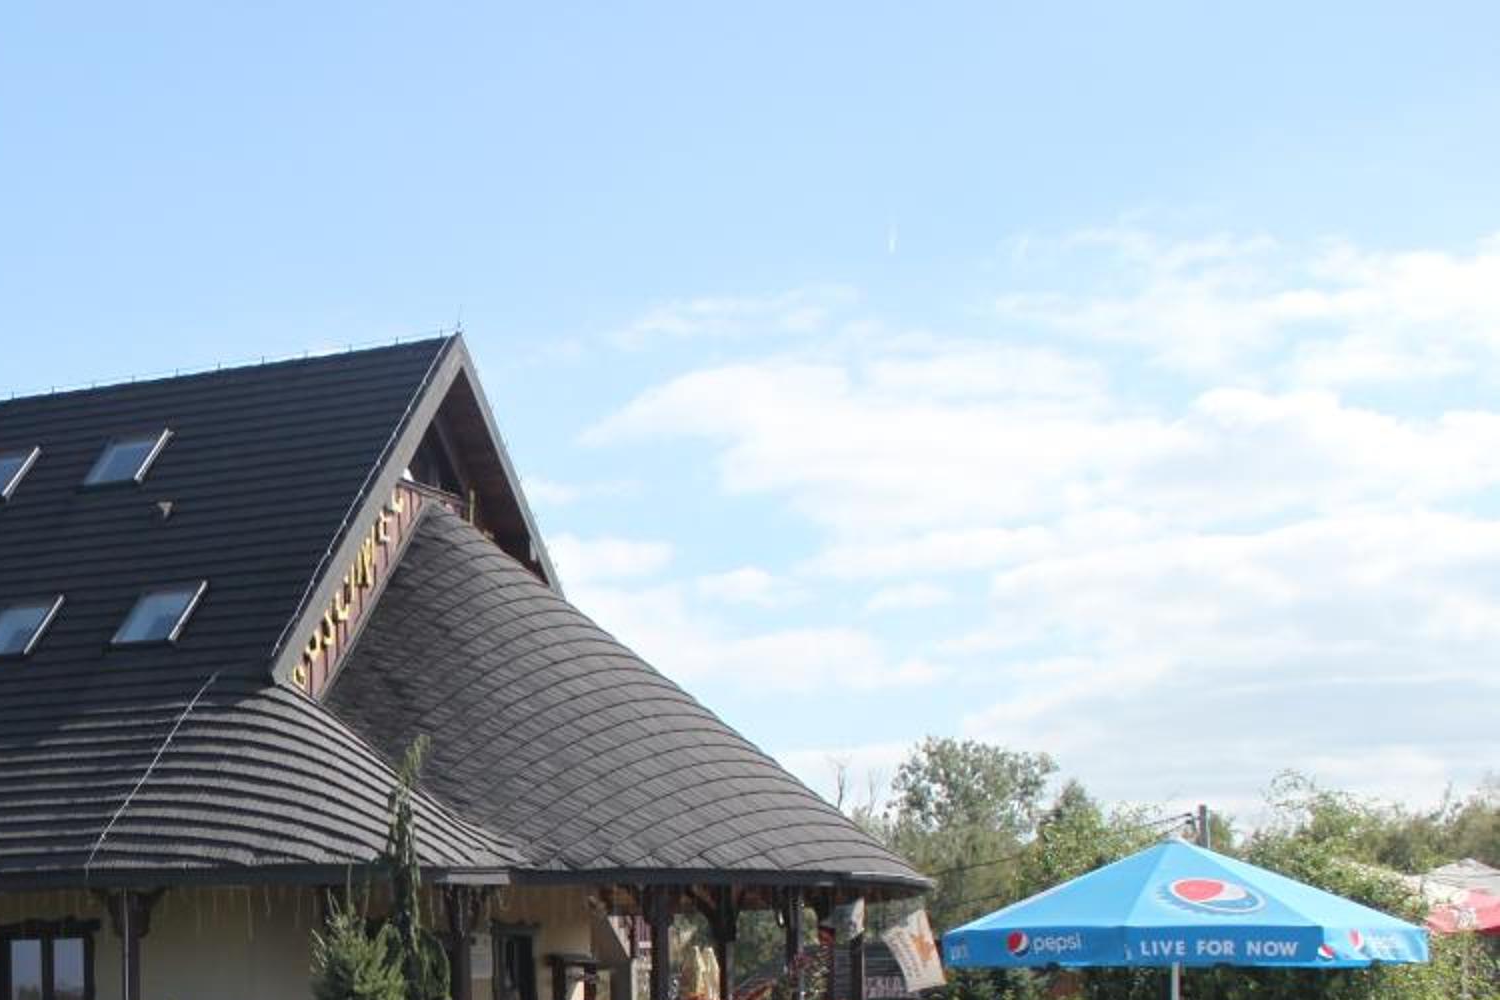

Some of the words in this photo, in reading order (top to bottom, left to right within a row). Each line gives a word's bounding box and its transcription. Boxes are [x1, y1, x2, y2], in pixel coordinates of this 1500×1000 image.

[1033, 932, 1082, 955] pepsi
[1140, 941, 1186, 956] LIVE
[1197, 940, 1235, 957] FOR
[1246, 941, 1299, 957] NOW
